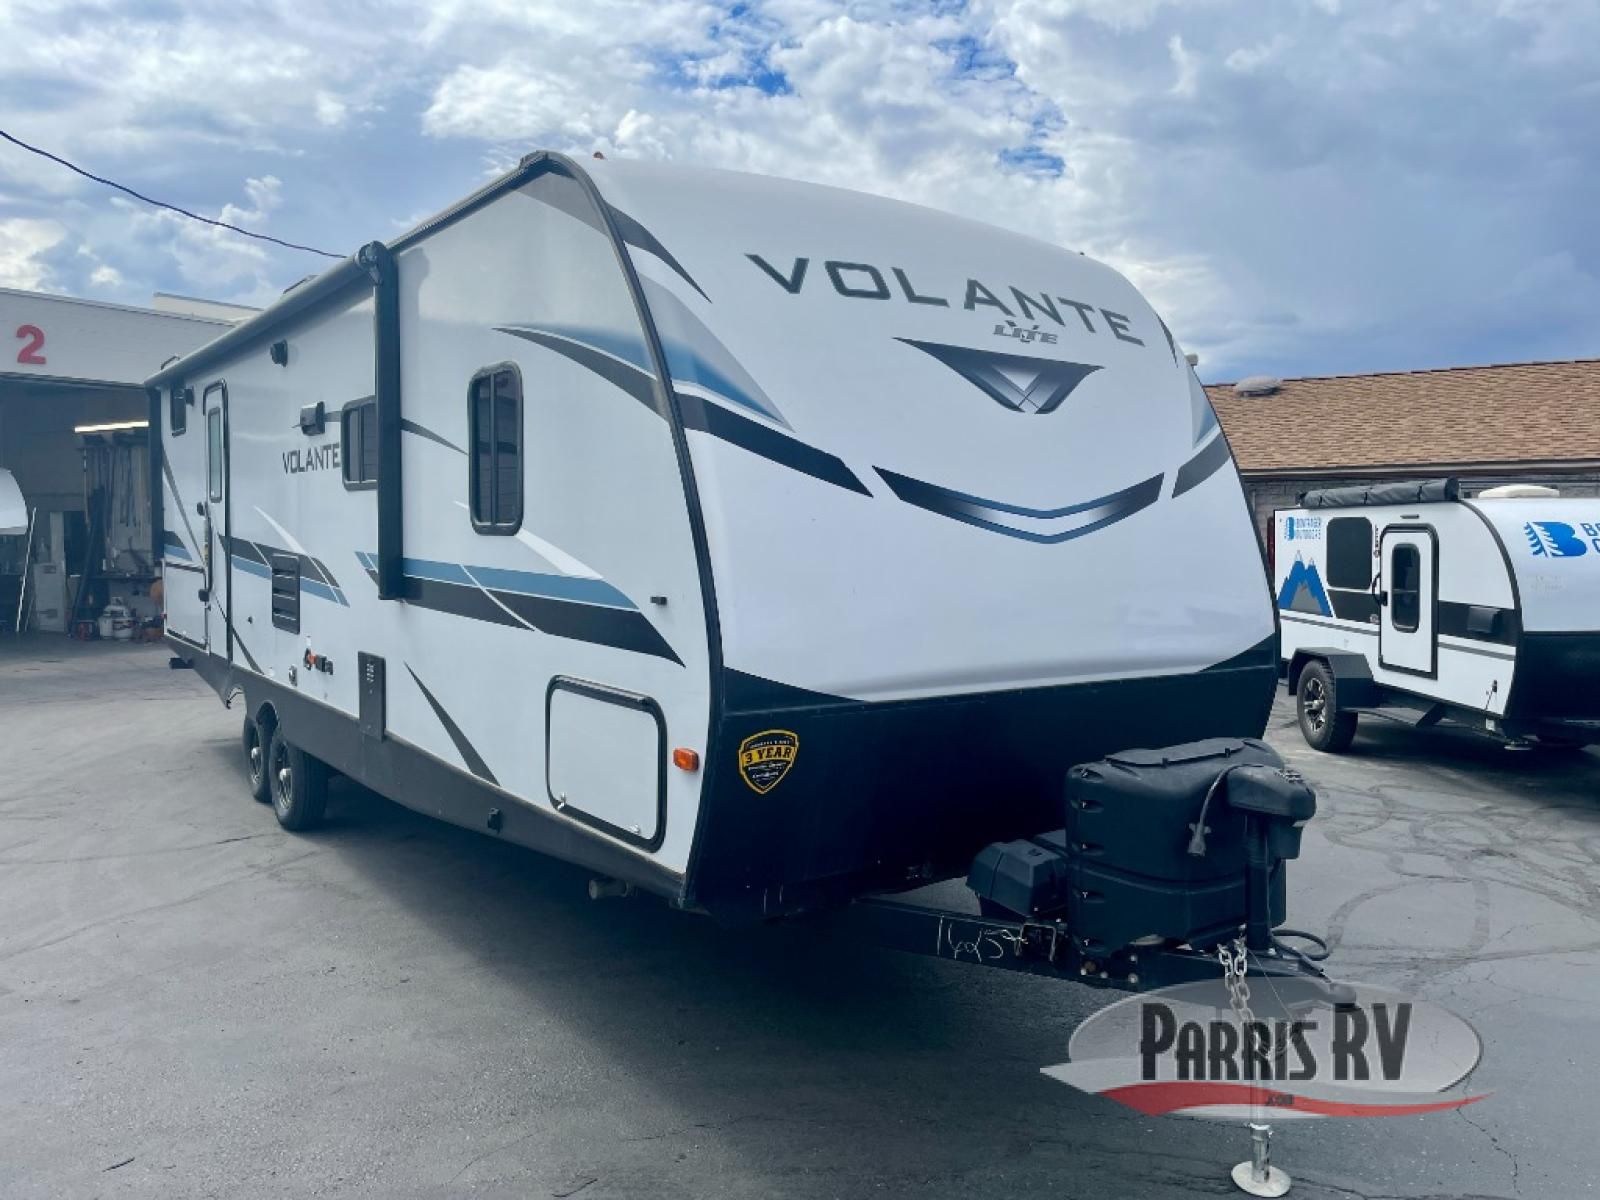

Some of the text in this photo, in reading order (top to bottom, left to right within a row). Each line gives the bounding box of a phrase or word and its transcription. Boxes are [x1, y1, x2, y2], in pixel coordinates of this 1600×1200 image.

[744, 253, 1145, 347] VOLANTE
[16, 324, 47, 364] 2
[992, 320, 1059, 344] LITE
[282, 443, 341, 474] VOLANTE
[757, 746, 792, 760] YEAR
